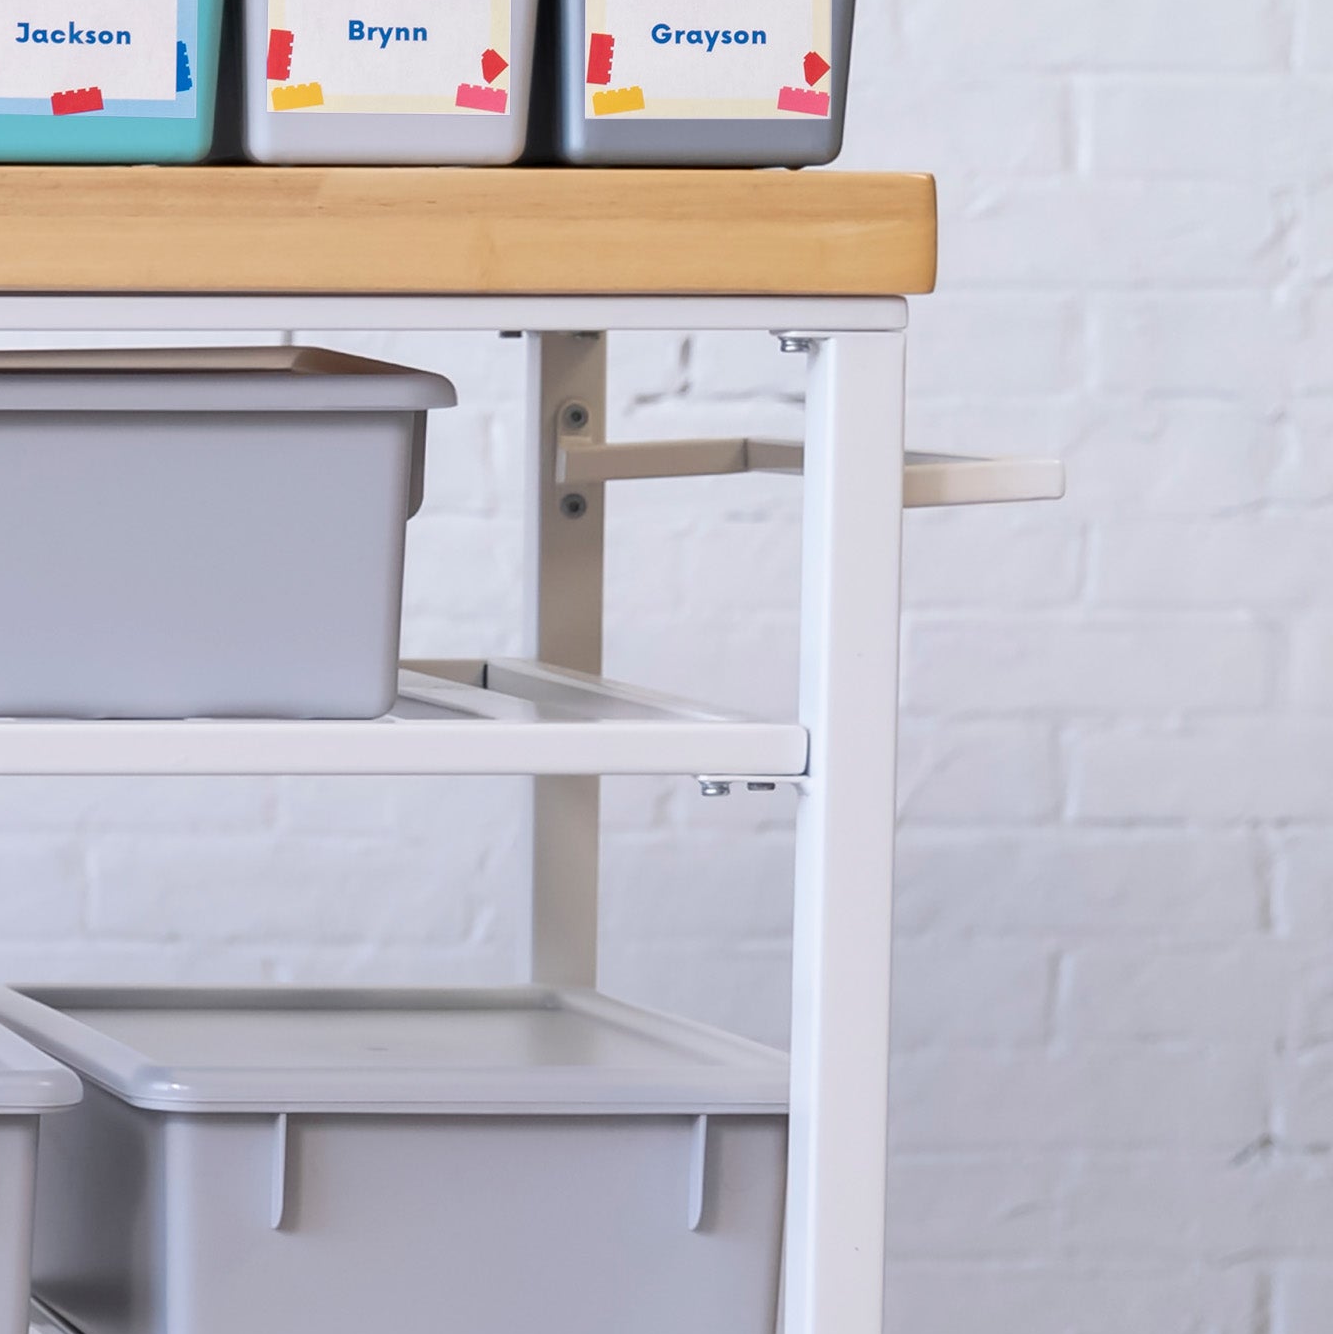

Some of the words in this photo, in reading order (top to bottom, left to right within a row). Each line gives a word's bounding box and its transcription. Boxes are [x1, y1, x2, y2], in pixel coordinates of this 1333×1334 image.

[15, 21, 131, 45] Jackson
[348, 19, 428, 49] Brynn
[651, 23, 767, 53] Grayson
